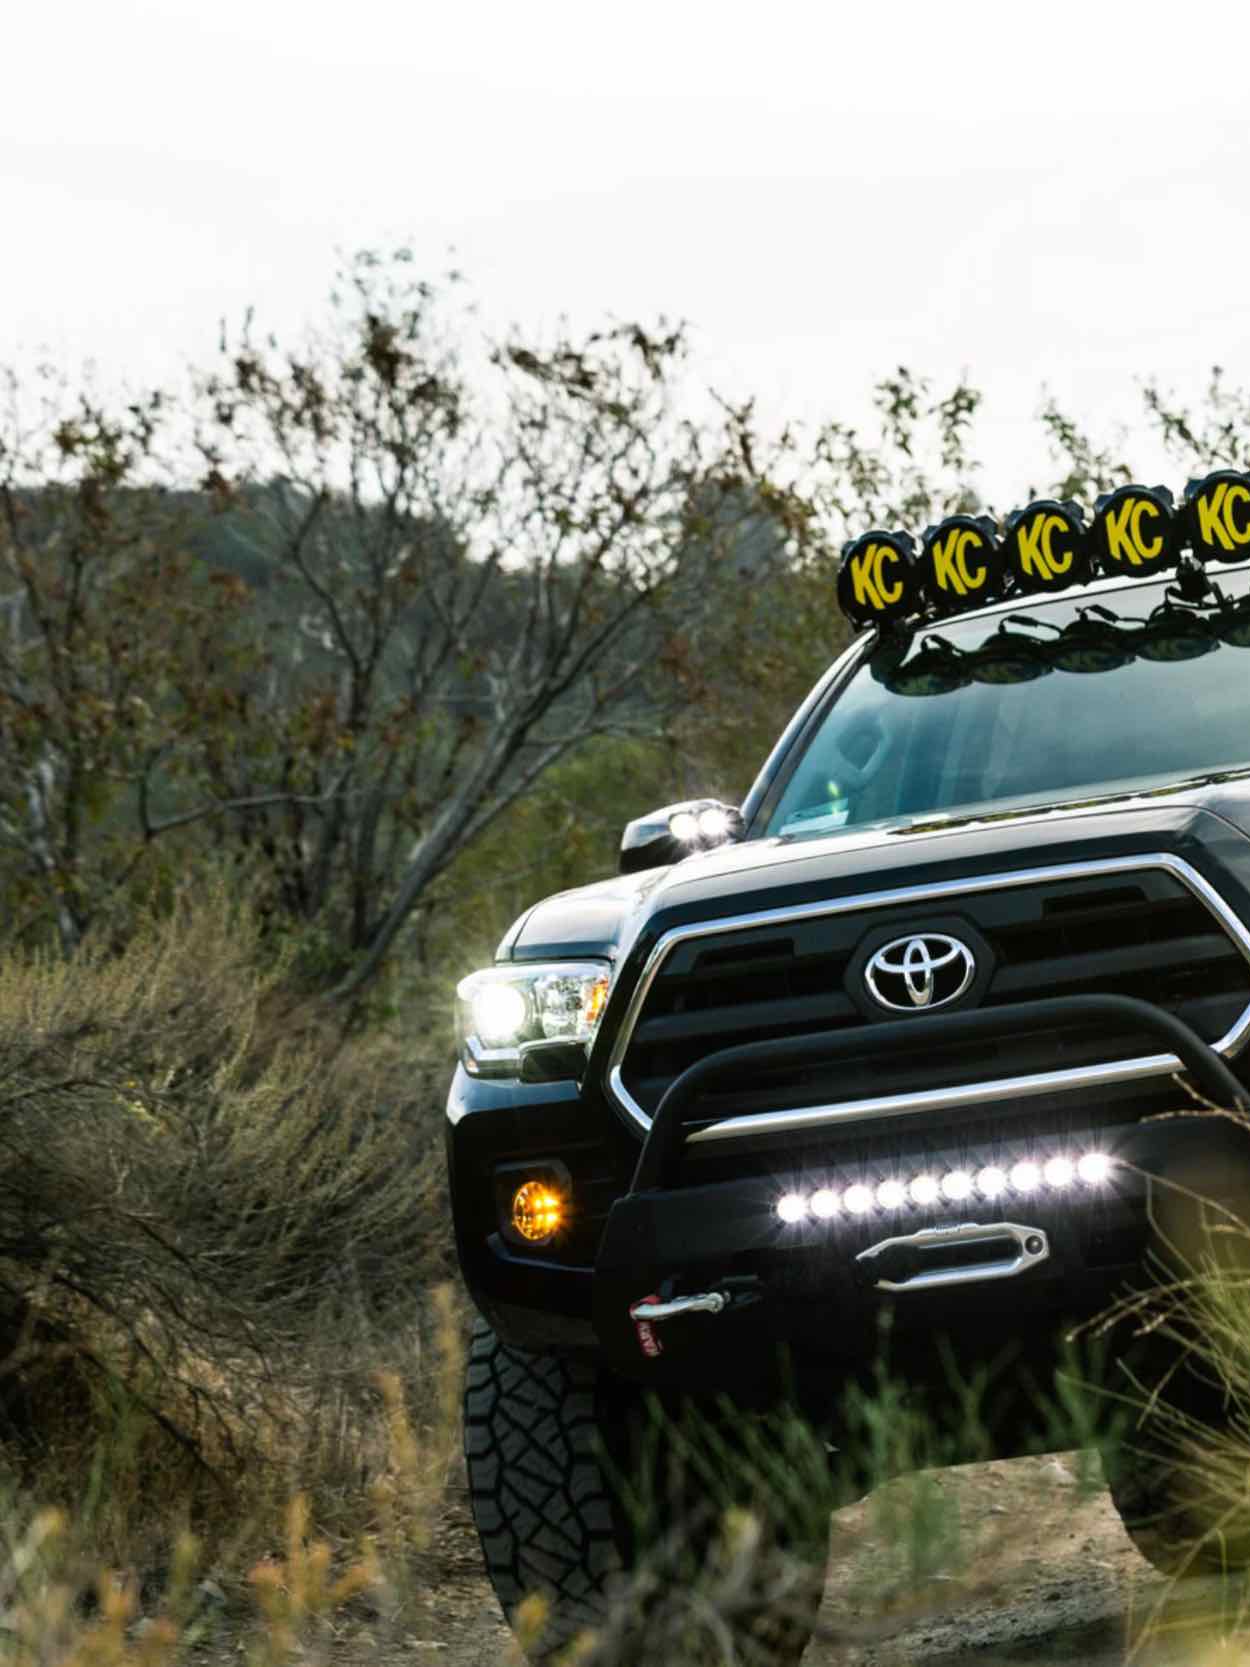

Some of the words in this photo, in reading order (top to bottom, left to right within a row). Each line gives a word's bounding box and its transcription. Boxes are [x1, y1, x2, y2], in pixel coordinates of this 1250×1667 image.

[933, 530, 986, 594] KC
[1017, 513, 1073, 580] KC
[1105, 499, 1163, 565] KC
[851, 545, 903, 609] KC
